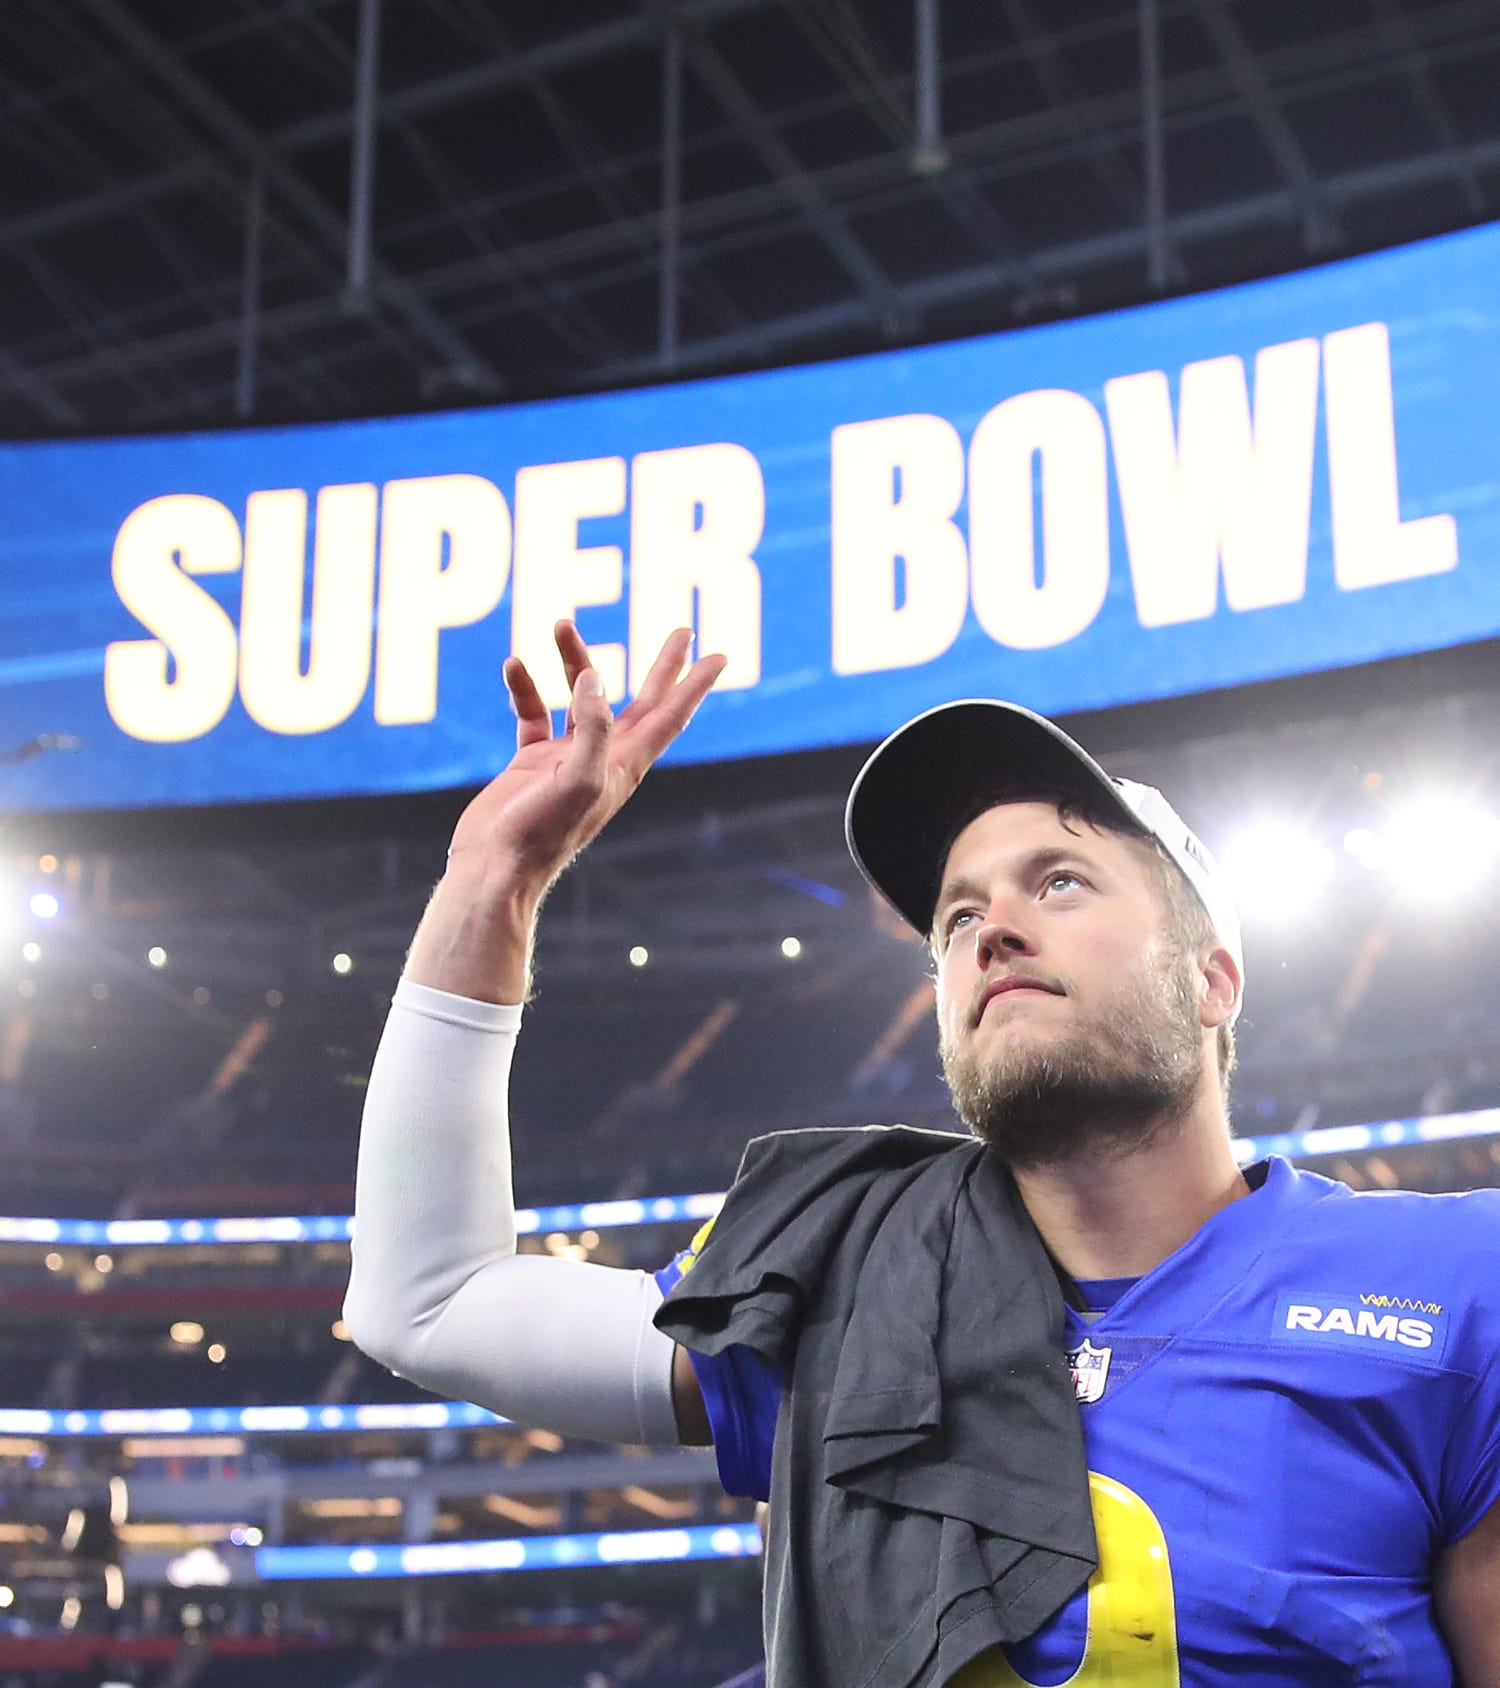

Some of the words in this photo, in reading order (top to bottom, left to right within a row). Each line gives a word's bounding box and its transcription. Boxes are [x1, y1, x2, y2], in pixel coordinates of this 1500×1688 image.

[102, 442, 766, 743] SUPER
[830, 321, 1460, 676] BOWL
[1285, 1304, 1435, 1349] RAMS
